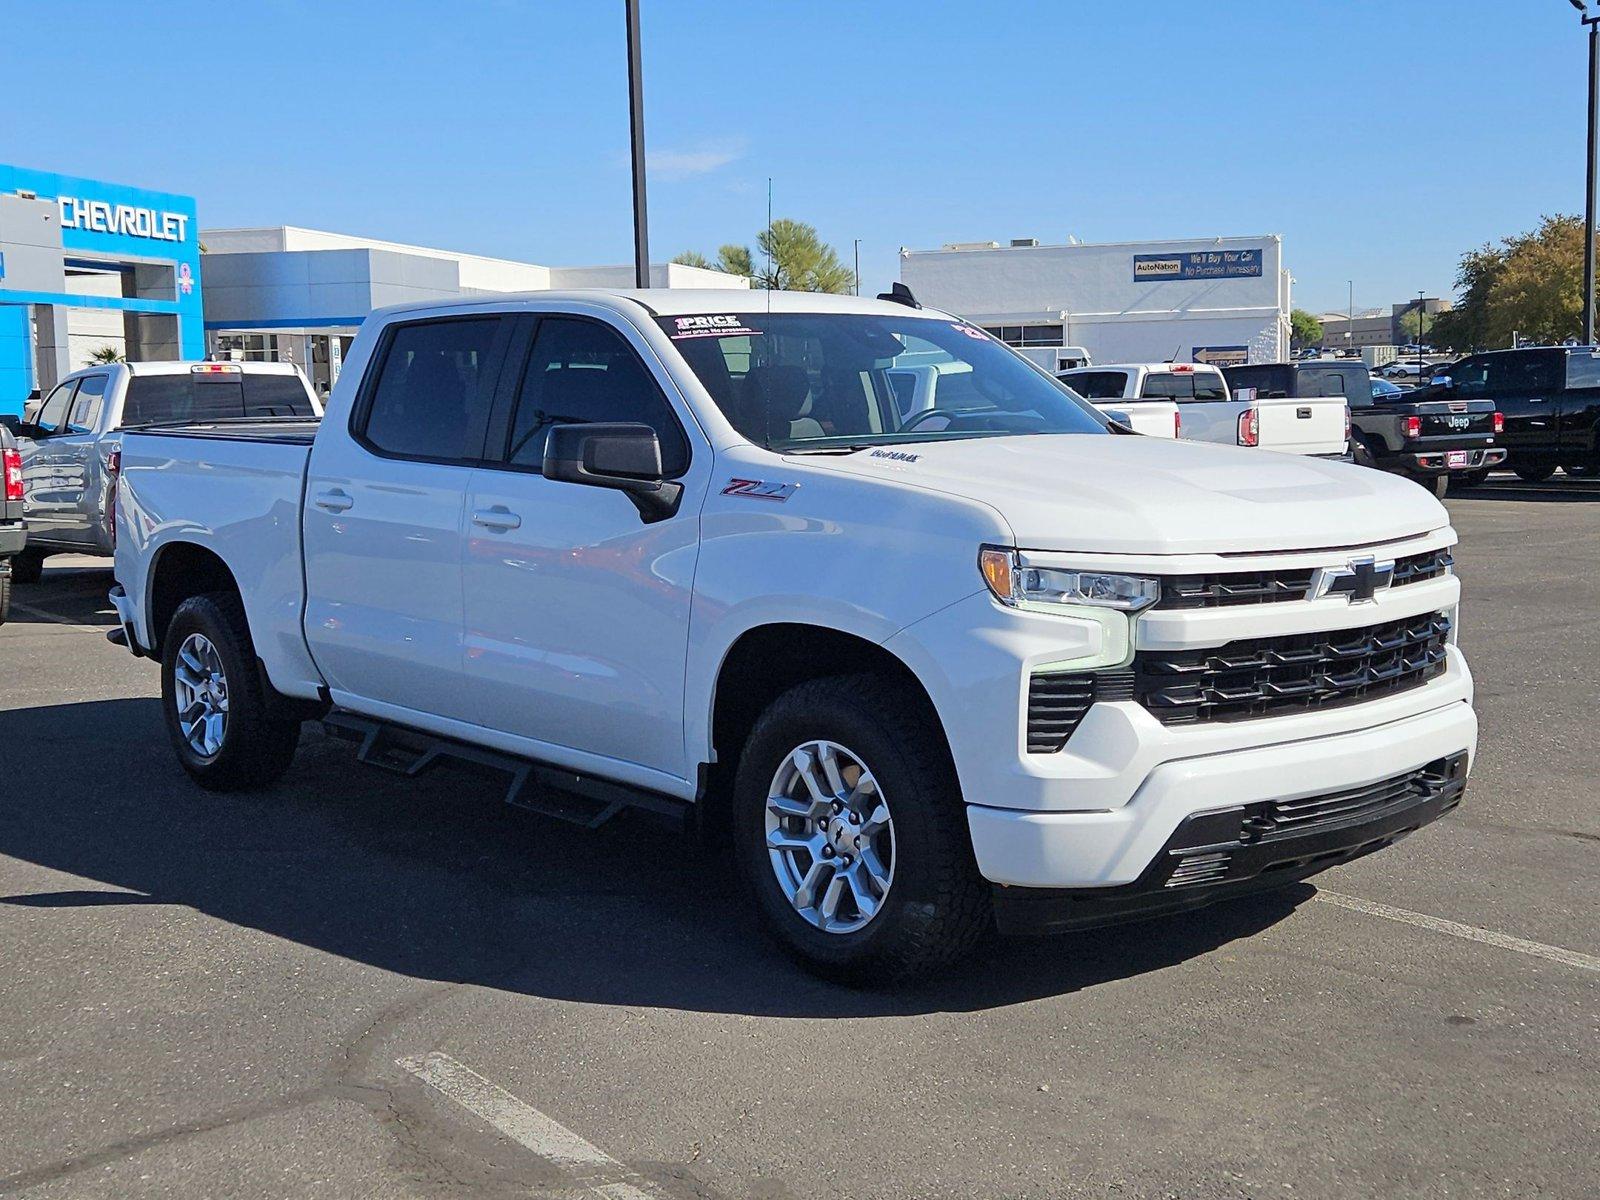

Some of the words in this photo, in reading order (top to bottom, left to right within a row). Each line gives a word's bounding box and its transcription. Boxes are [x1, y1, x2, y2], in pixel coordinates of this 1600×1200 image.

[58, 196, 188, 241] CHEVROLET
[1208, 253, 1220, 264] Buy
[1224, 252, 1238, 262] Your
[1136, 262, 1179, 272] AutoNation
[1185, 266, 1195, 276] No
[1196, 266, 1225, 275] Purchase
[1448, 416, 1470, 429] Jeep
